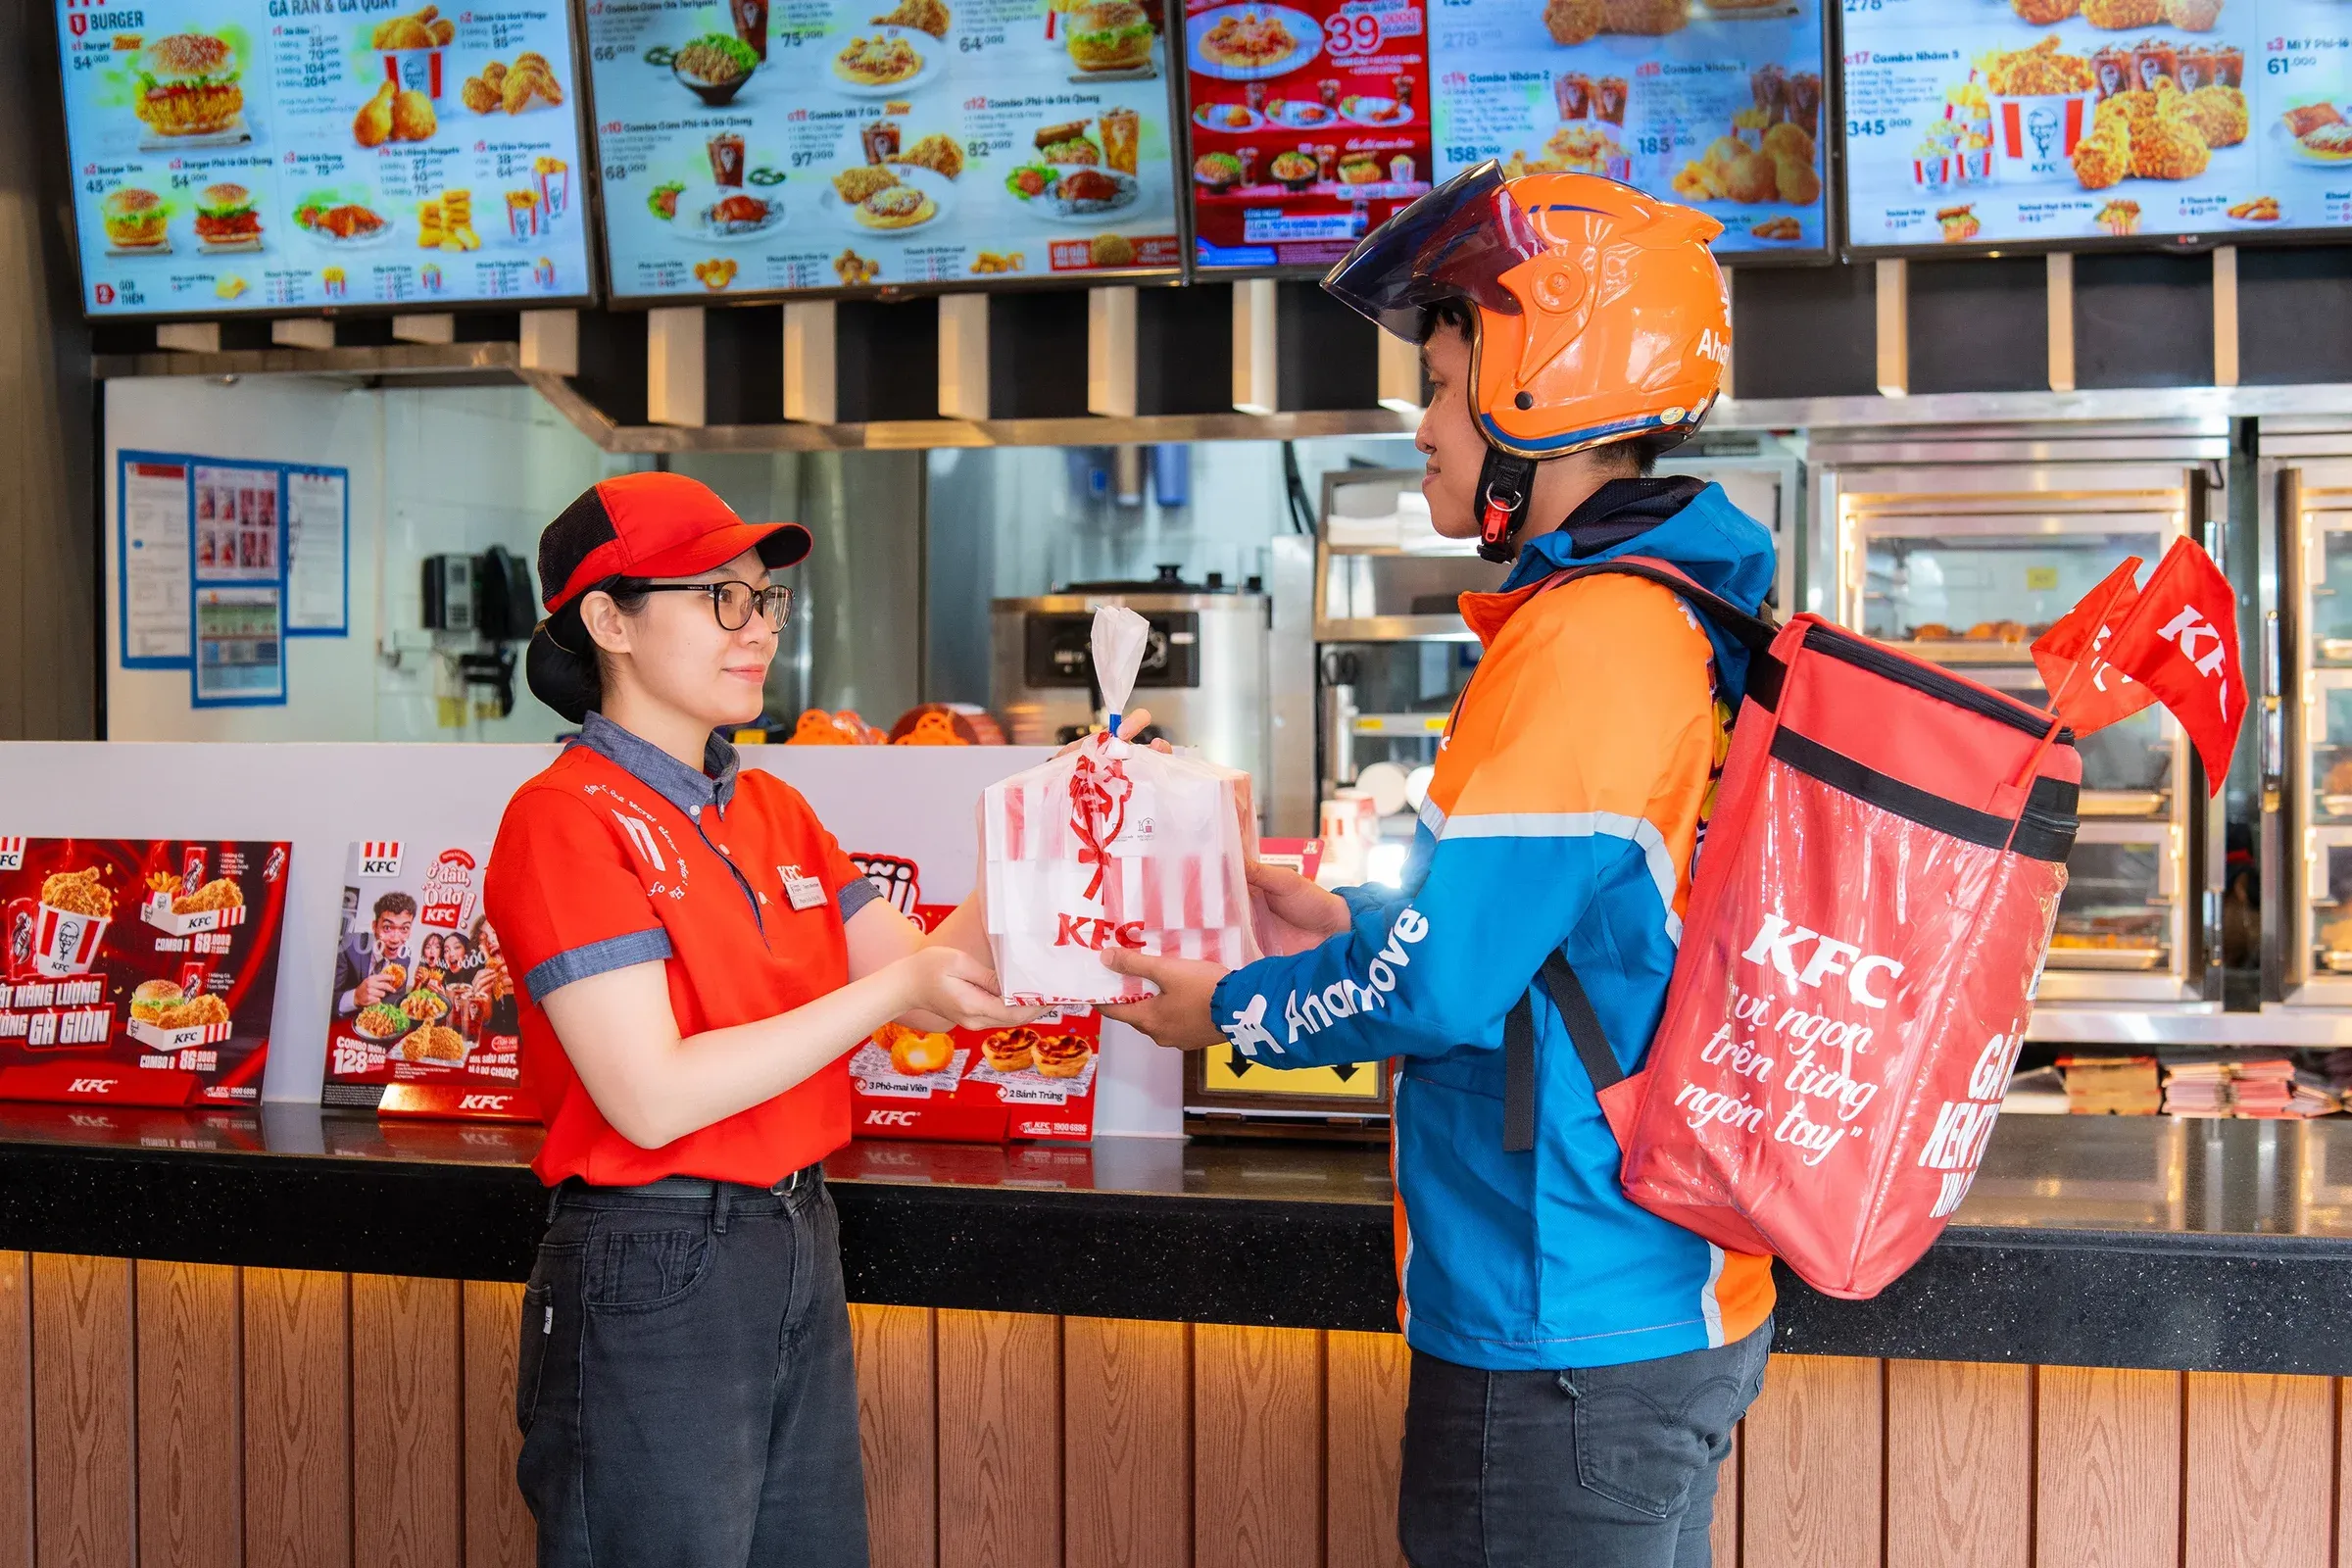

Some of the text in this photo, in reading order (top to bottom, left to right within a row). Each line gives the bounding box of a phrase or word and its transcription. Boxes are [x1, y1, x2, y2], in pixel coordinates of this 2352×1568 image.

[89, 10, 145, 30] BURGER
[1332, 14, 1379, 51] 39
[1873, 53, 1913, 64] Combo
[2267, 57, 2317, 74] 61.000
[792, 150, 834, 167] 97.000
[364, 861, 397, 873] KFC
[776, 864, 804, 884] KFC
[187, 916, 212, 929] KFC
[424, 908, 456, 922] KFC
[1054, 912, 1148, 951] KFC
[155, 938, 183, 952] COMBO
[51, 961, 70, 972] KFC
[1741, 911, 1905, 1010] KFC
[14, 981, 55, 1008] NĂNG
[28, 1007, 58, 1046] GÀ
[1774, 1007, 1874, 1057] ngon
[173, 1032, 198, 1045] KFC
[336, 1036, 368, 1052] COMBO
[140, 1054, 168, 1068] COMBO
[1700, 1022, 1879, 1122] trên từng
[68, 1079, 112, 1093] KFC
[868, 1081, 928, 1093] 3 Phô-mai Viên
[458, 1095, 509, 1109] KFC
[1015, 1090, 1037, 1100] Bánh
[1674, 1080, 1765, 1133] ngón
[863, 1110, 913, 1126] KFC
[1054, 1123, 1069, 1132] 1900
